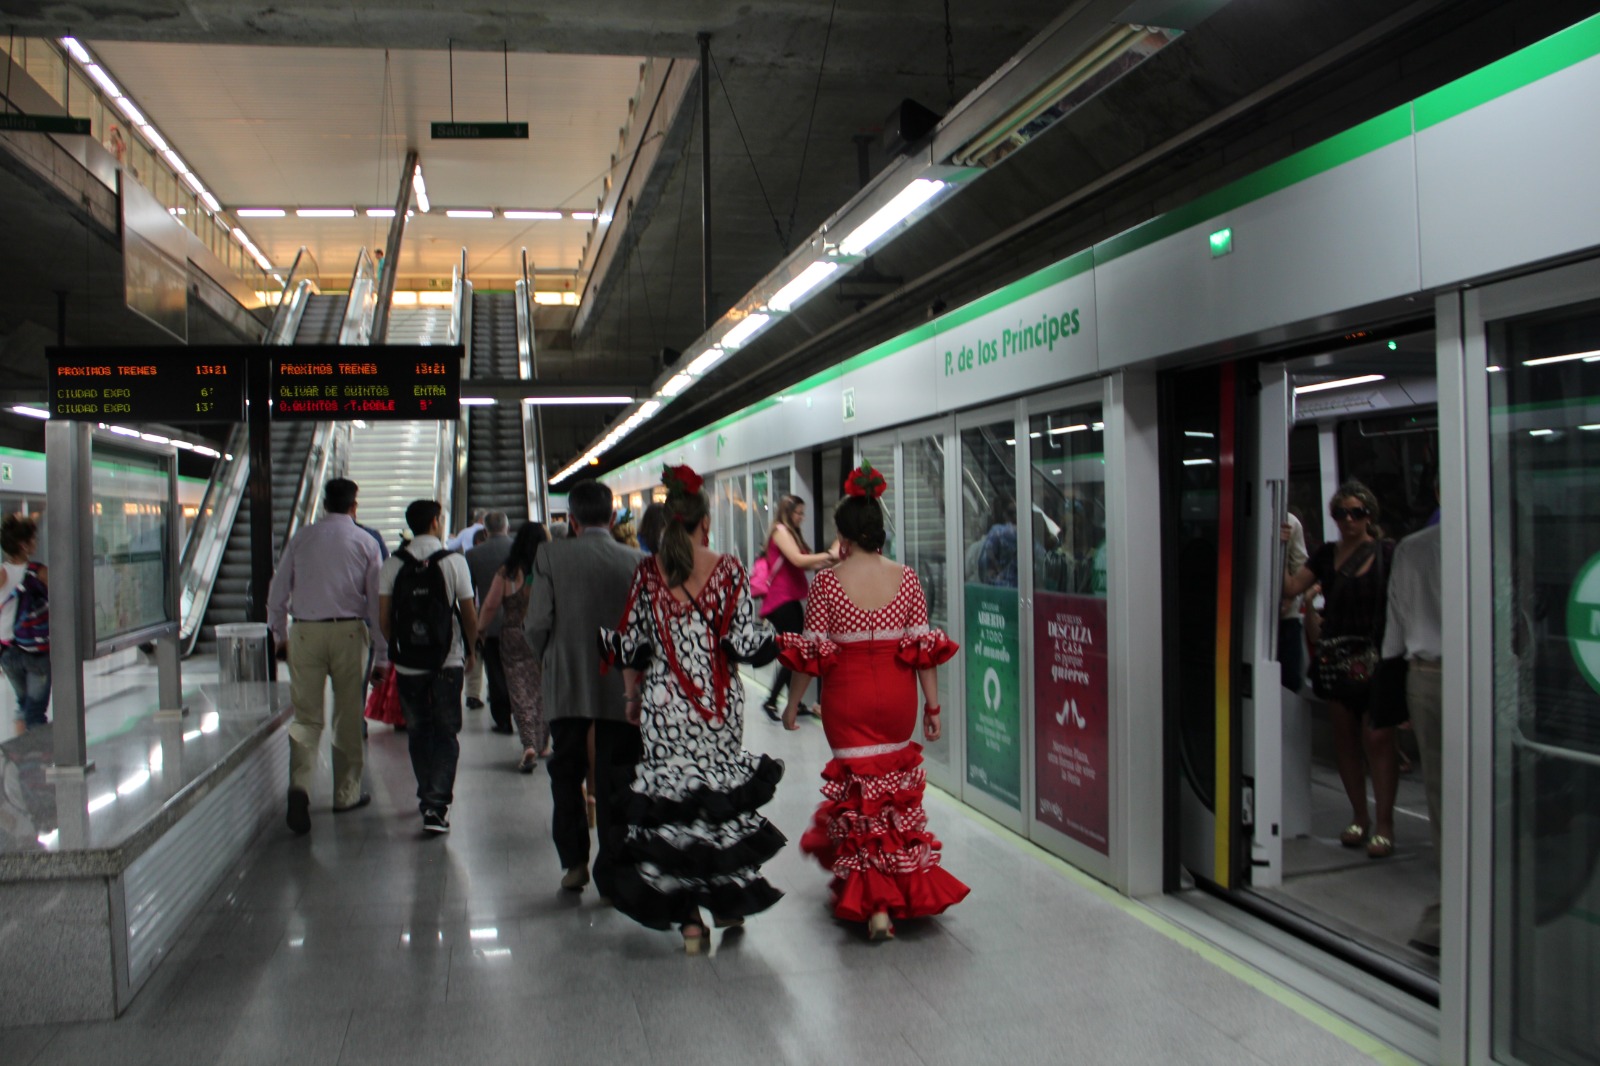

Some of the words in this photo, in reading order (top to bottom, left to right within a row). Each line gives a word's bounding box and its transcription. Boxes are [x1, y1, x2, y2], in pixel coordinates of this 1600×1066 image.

[437, 124, 480, 137] Salida
[945, 351, 953, 376] P.
[958, 345, 974, 372] de
[978, 339, 998, 366] los
[1002, 308, 1080, 357] Príncipes
[57, 366, 112, 376] PROXIMOS
[117, 365, 158, 376] TRENES
[195, 365, 227, 375] 13:21
[280, 363, 333, 375] PROXIMOS
[338, 363, 378, 375] TRENES
[415, 362, 446, 375] 13:21
[57, 388, 98, 399] CIUDAD
[103, 388, 131, 398] EXPO
[280, 385, 319, 397] OLIVAR
[325, 385, 339, 397] DE
[344, 385, 389, 397] QUINTOS
[413, 384, 447, 396] ENTRA
[57, 403, 98, 414] CIUDAD
[103, 403, 131, 413] EXPO
[978, 611, 1005, 629] ABIERTO
[980, 629, 985, 640] A
[986, 629, 1004, 644] TODO
[1047, 620, 1093, 645] DESCALZA
[974, 640, 983, 656] el
[983, 645, 1010, 663] mundo
[1054, 639, 1060, 651] A
[1062, 641, 1083, 656] CASA
[1051, 665, 1090, 685] quieres
